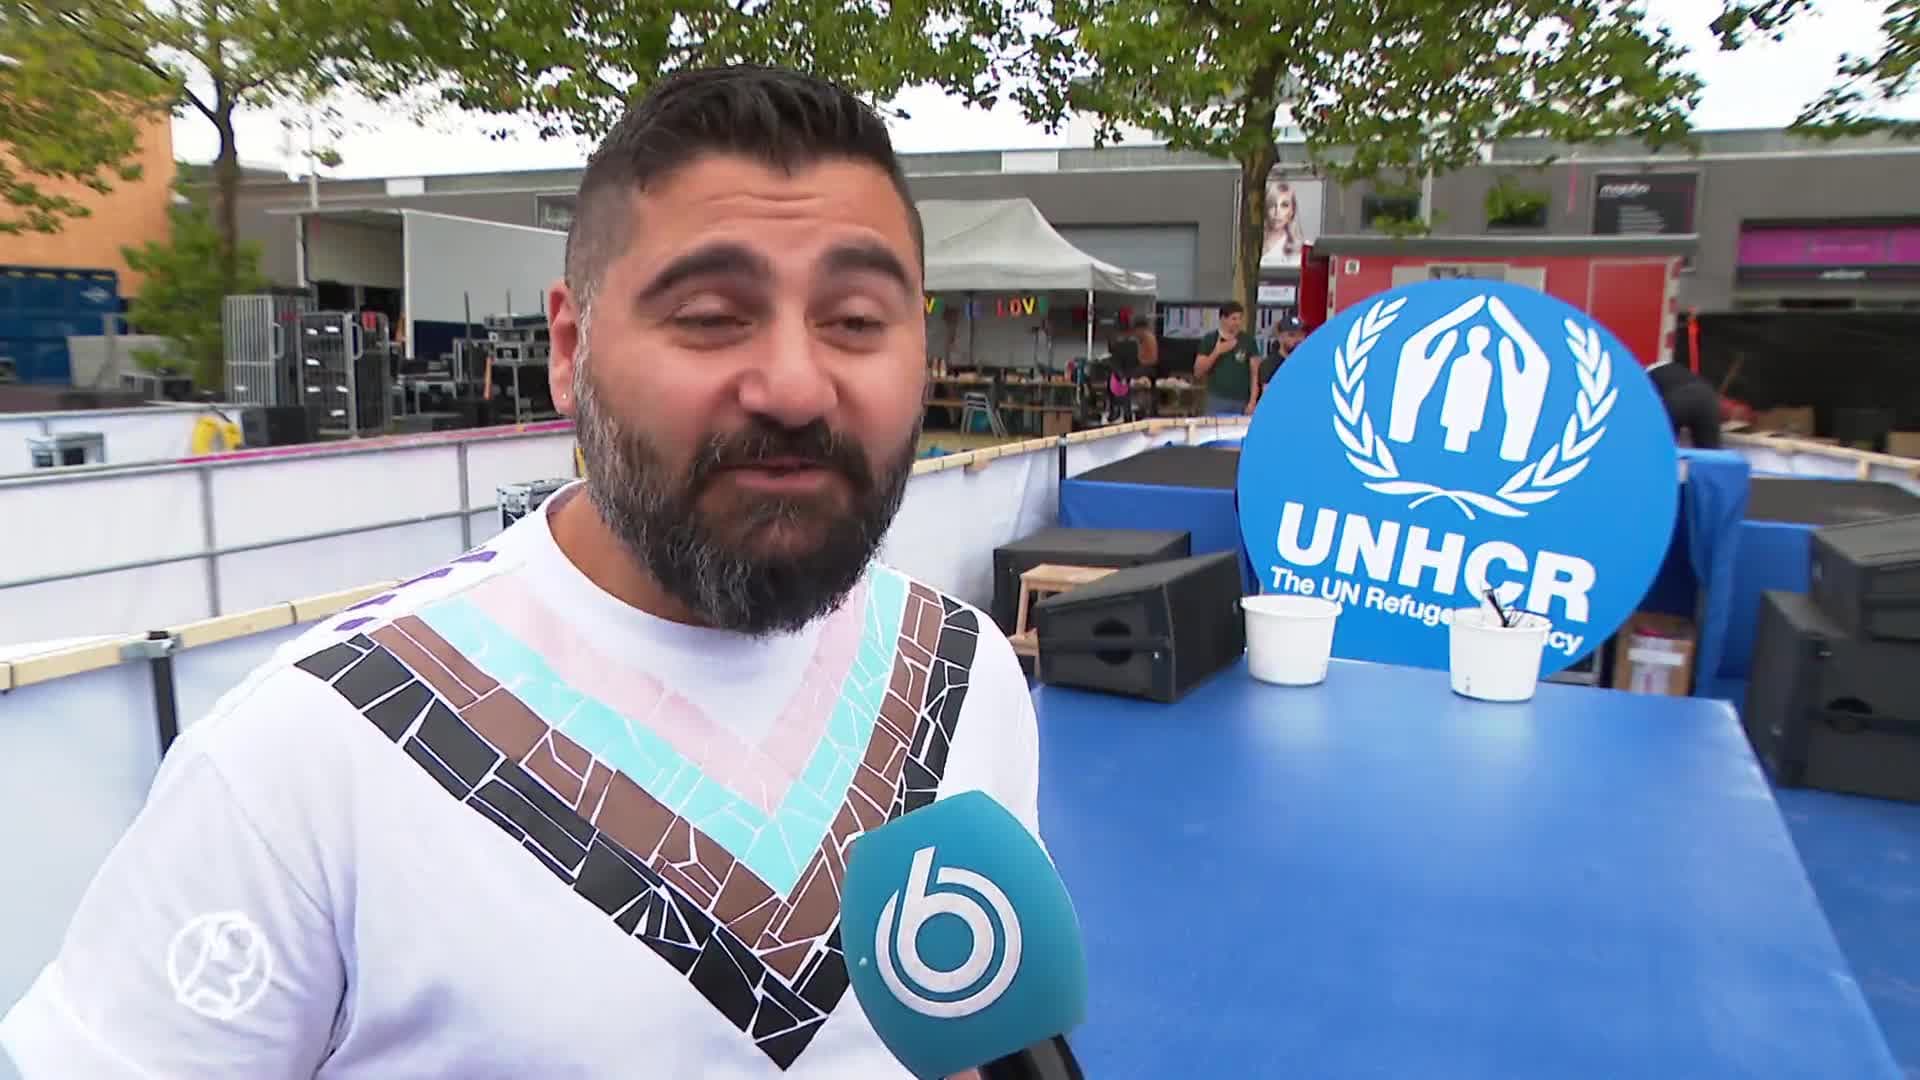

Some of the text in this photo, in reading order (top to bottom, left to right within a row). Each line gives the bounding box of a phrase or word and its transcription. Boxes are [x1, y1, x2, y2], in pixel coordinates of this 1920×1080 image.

[1270, 566, 1455, 627] The UN Refuge
[1275, 501, 1597, 622] UNHCR
